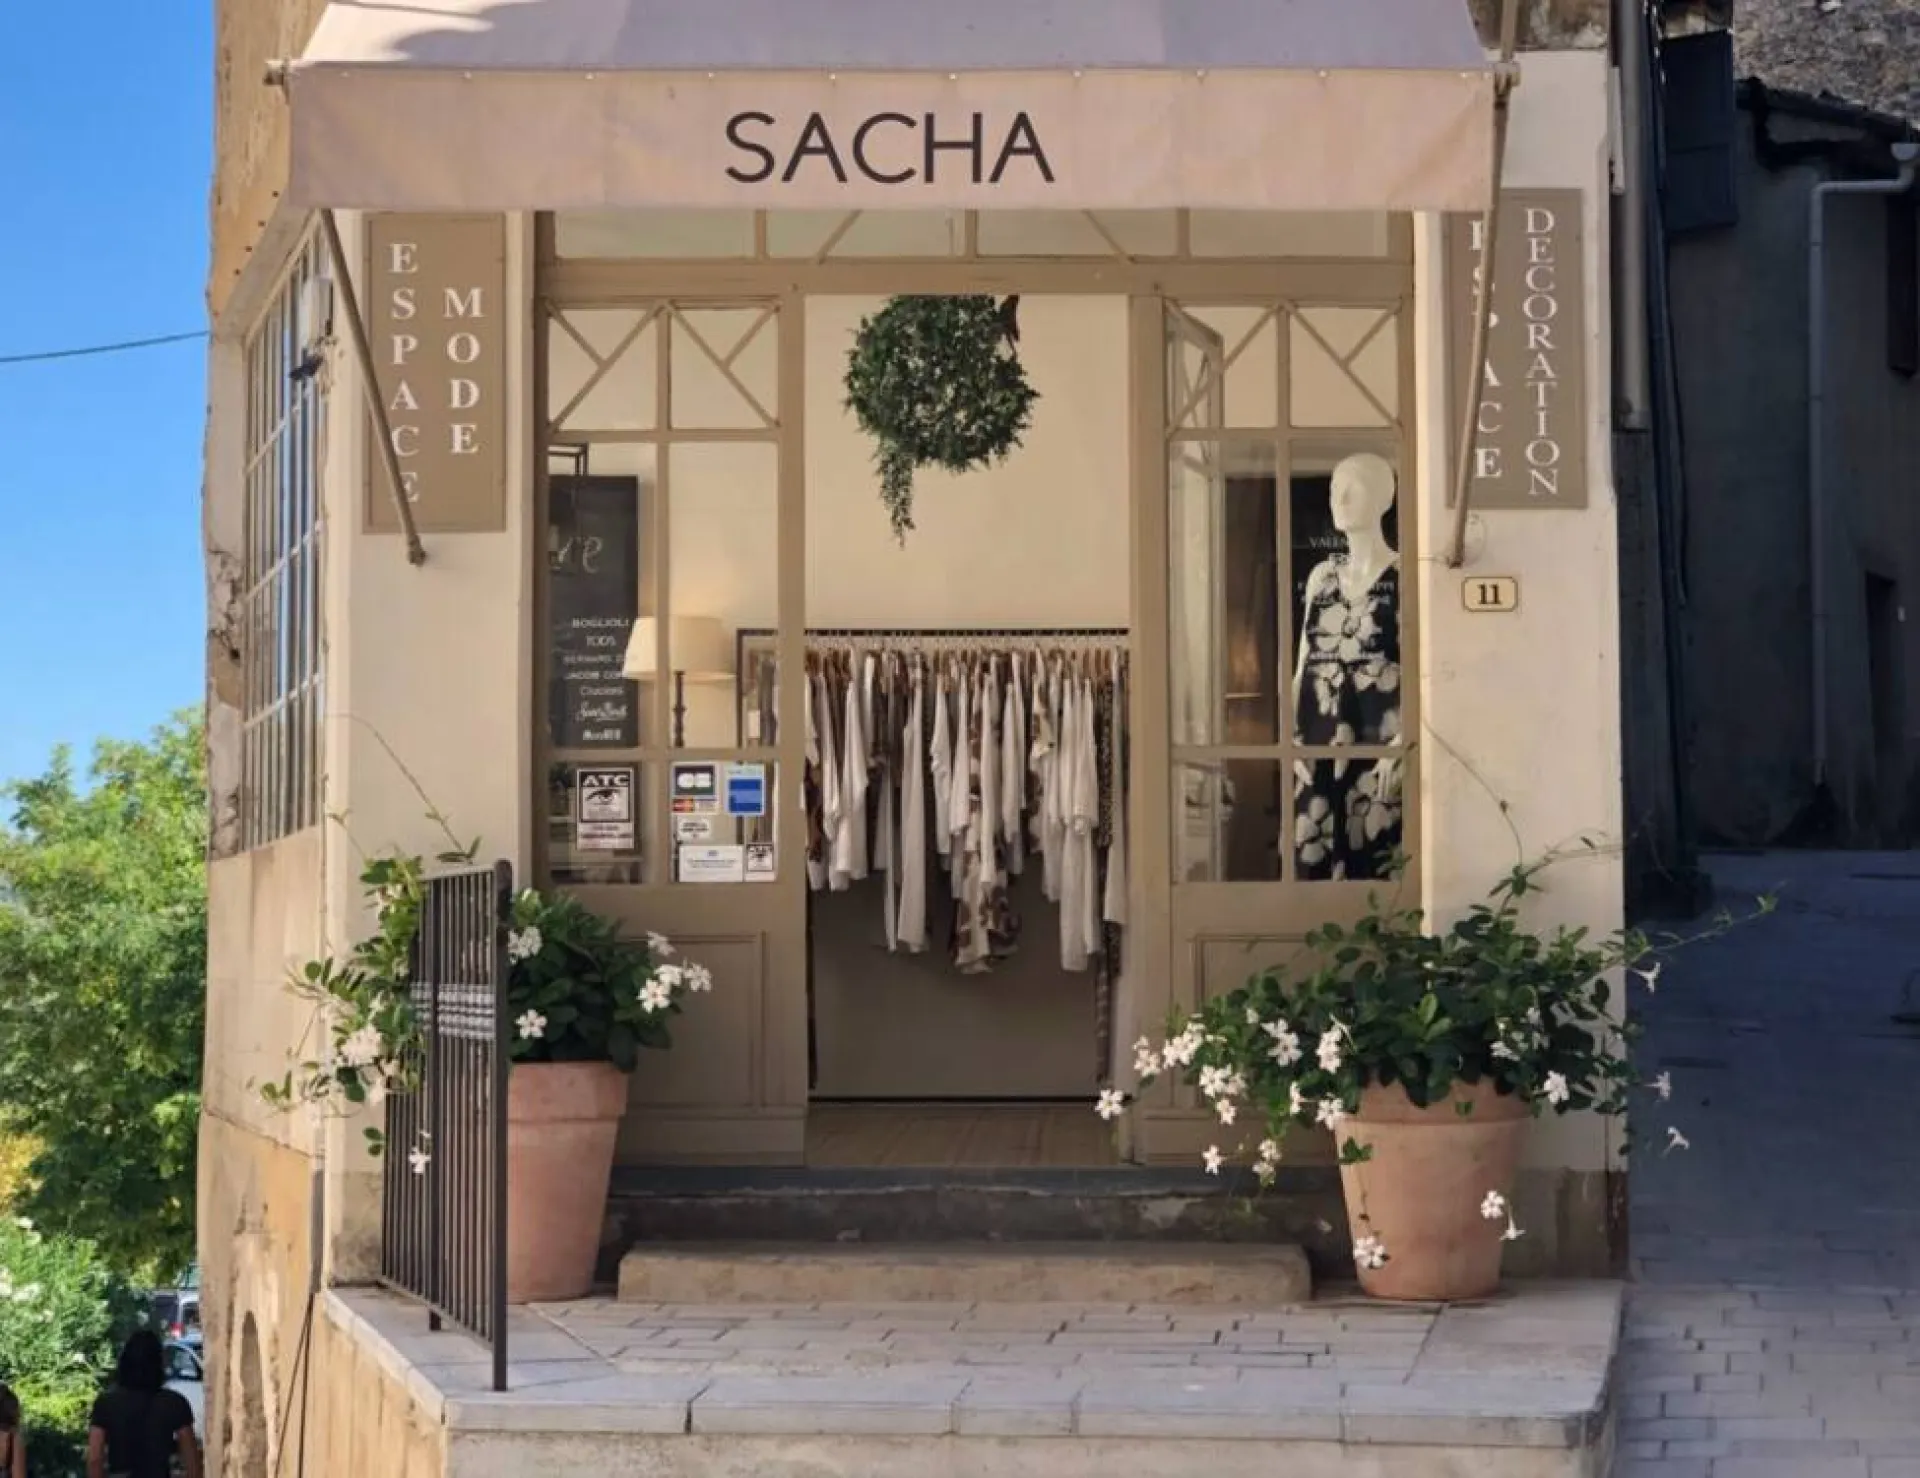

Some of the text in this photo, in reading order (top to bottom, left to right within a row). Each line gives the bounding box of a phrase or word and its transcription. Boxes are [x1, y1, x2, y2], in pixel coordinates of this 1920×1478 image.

[725, 110, 1055, 184] SACHA
[388, 241, 421, 504] ESPACE
[442, 286, 486, 455] MODE
[1522, 207, 1561, 496] DECORATION
[1476, 583, 1502, 606] 11
[583, 774, 630, 786] ATC
